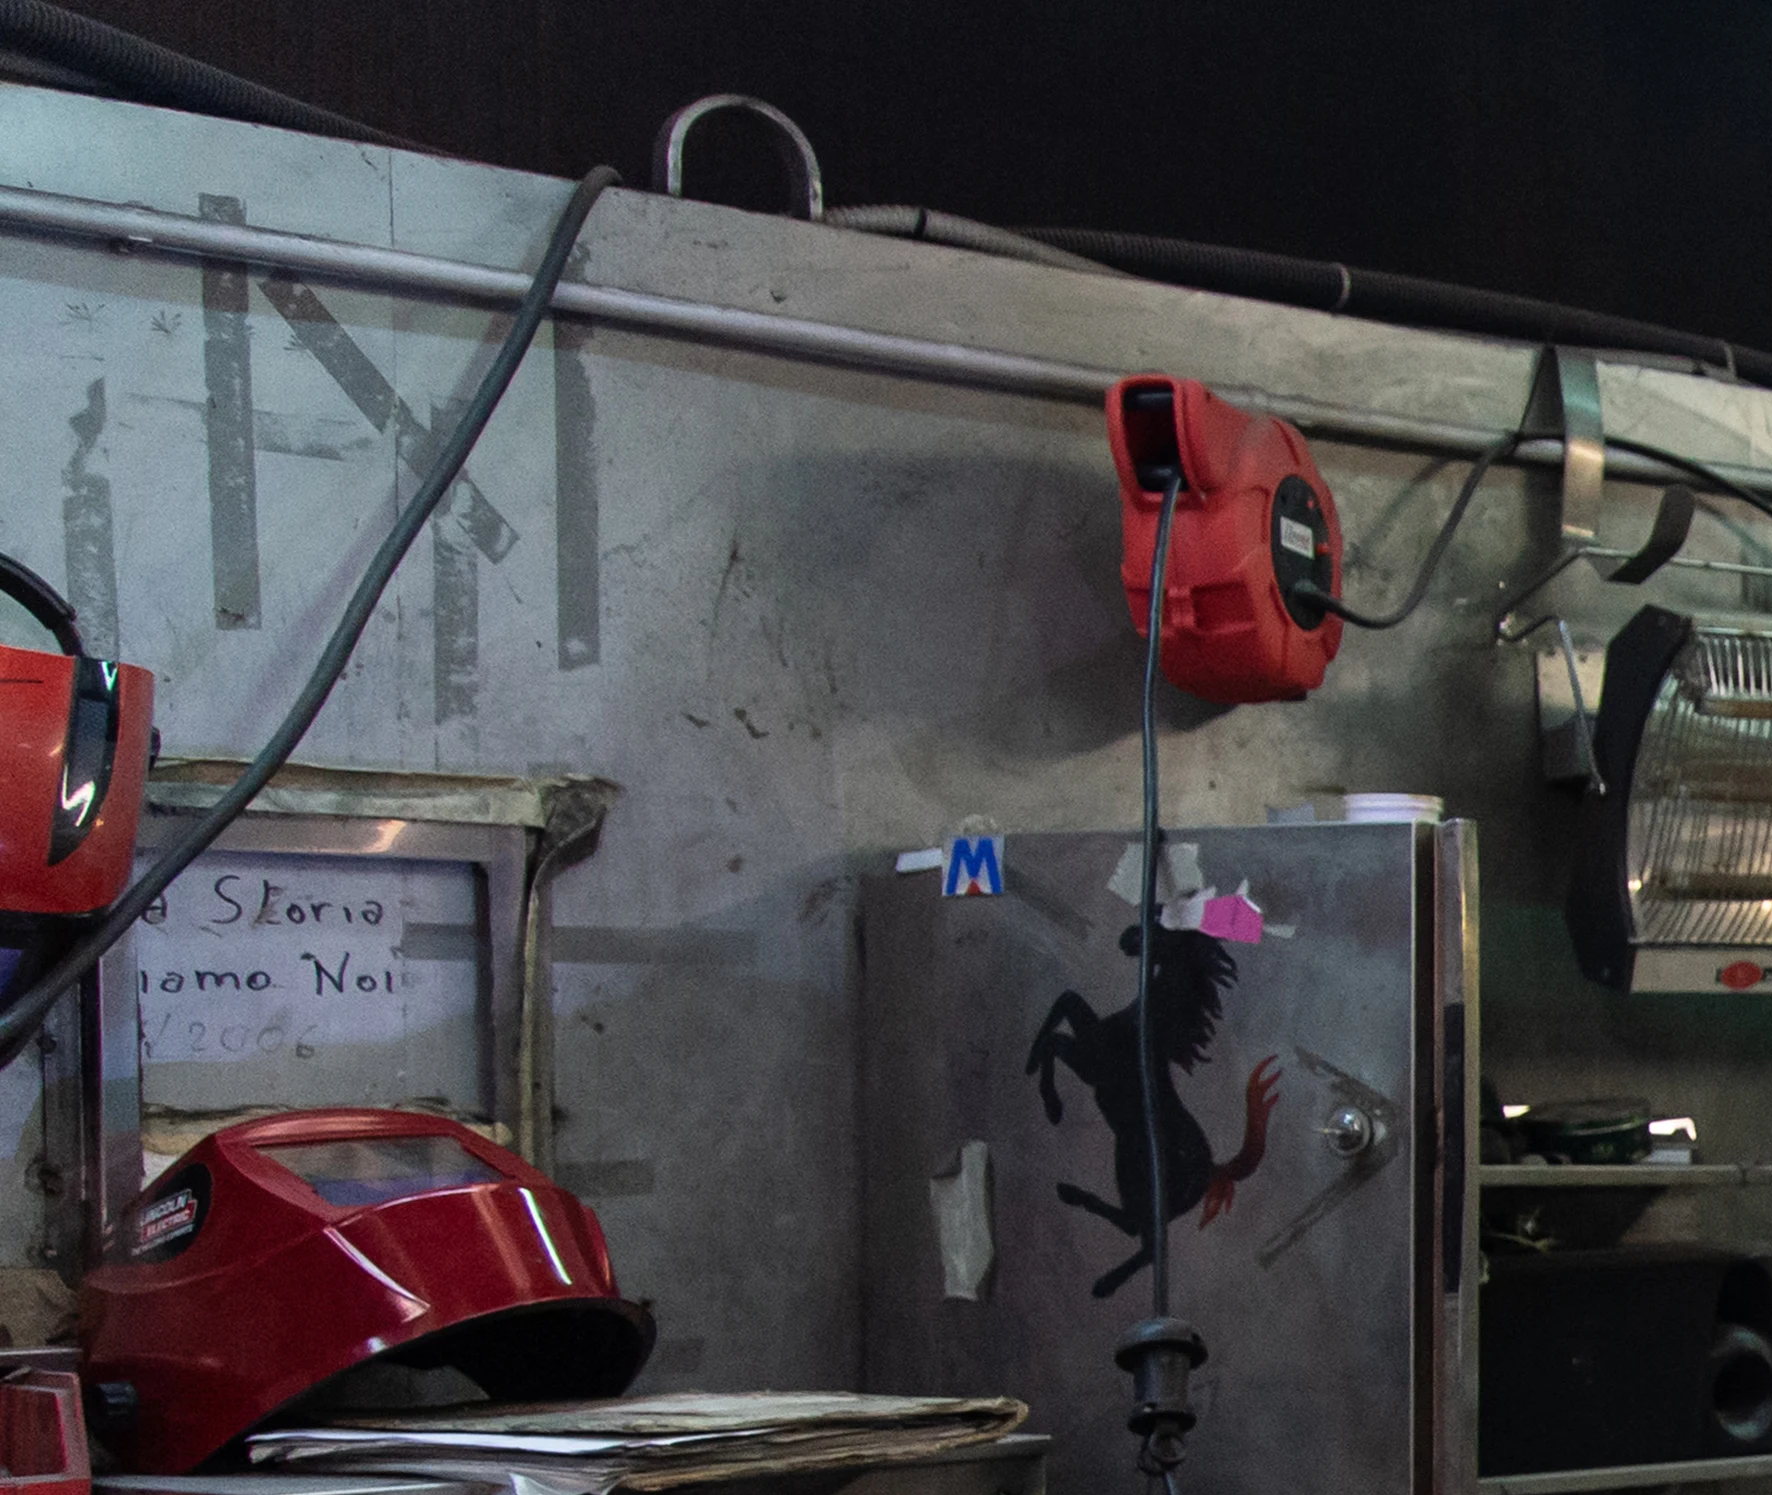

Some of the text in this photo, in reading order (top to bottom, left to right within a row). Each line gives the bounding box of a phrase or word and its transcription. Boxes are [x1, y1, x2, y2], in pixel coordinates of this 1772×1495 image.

[212, 874, 384, 928] Storia
[140, 951, 396, 996] iamo Noi
